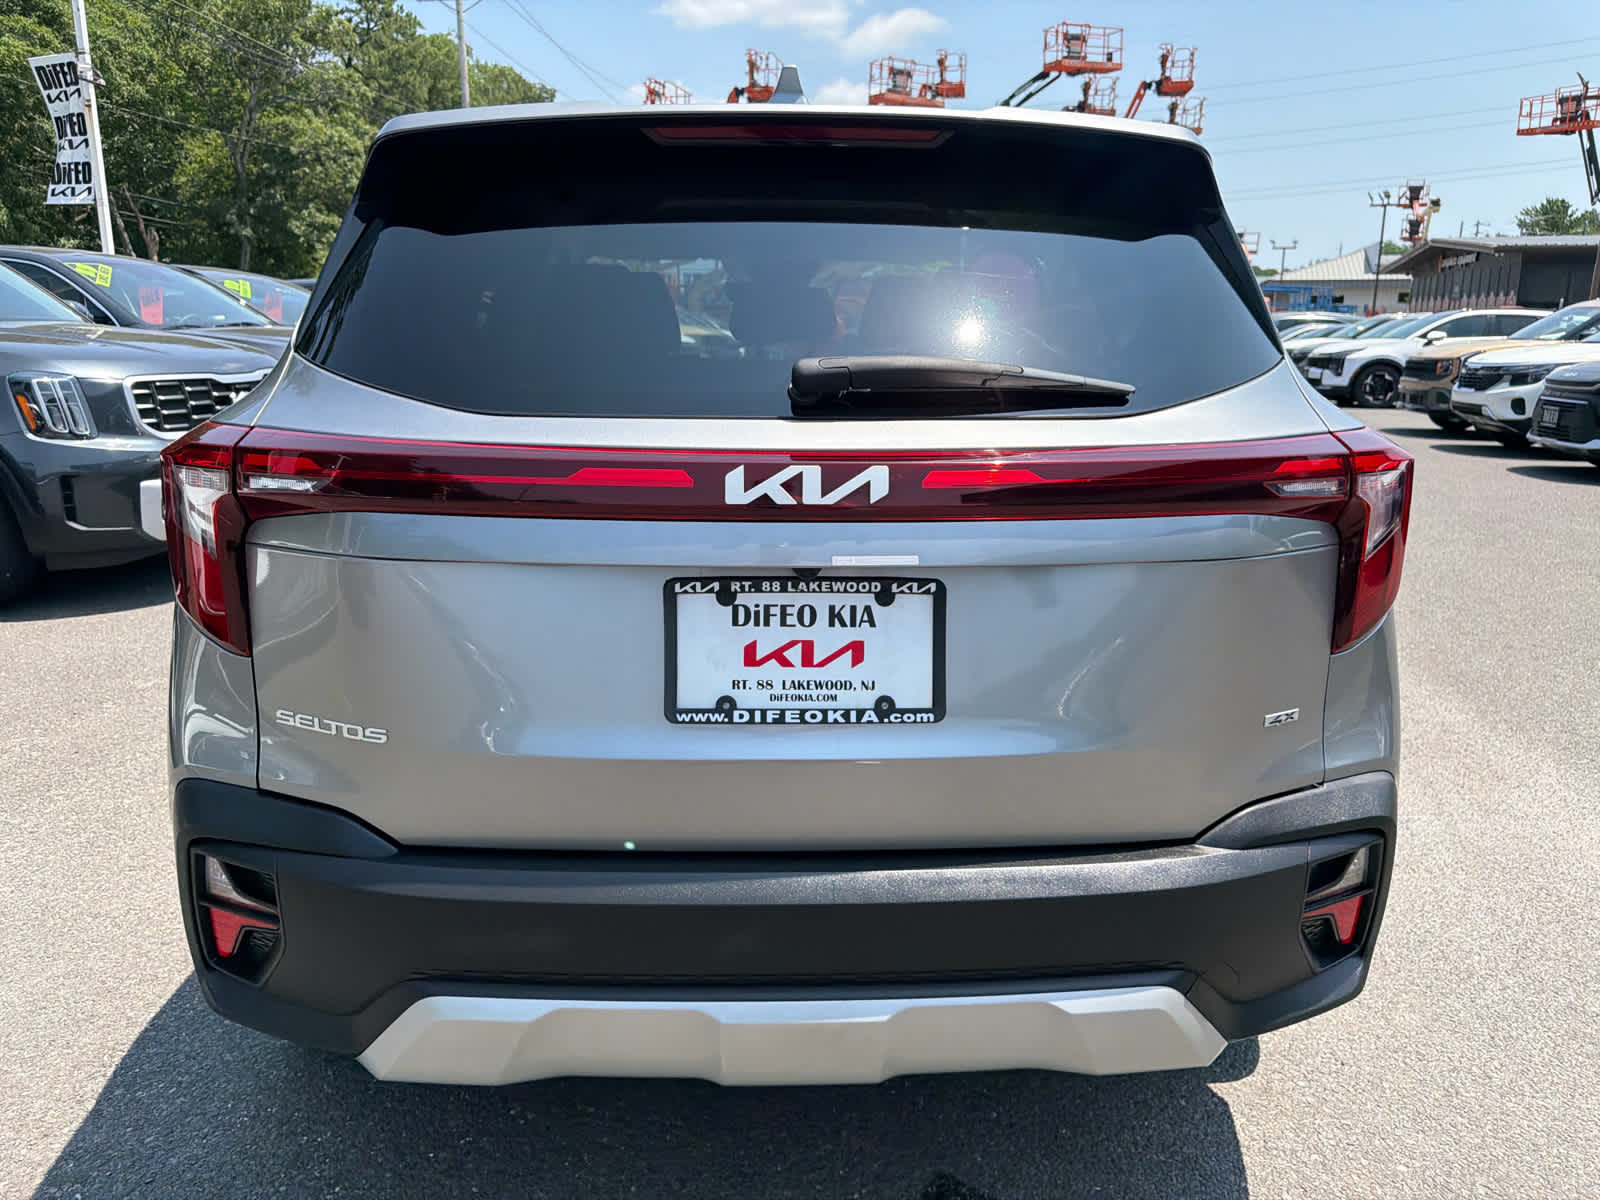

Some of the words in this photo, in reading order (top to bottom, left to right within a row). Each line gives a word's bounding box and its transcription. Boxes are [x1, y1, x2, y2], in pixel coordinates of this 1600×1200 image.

[46, 87, 82, 104] KIA
[50, 185, 92, 197] KIA
[724, 463, 890, 505] KIA
[674, 581, 720, 593] KIA
[730, 581, 756, 593] RT.
[761, 581, 781, 593] 88
[787, 581, 882, 593] LAKEWOOD
[891, 582, 937, 593] KIA
[731, 603, 818, 628] DiFEO
[828, 604, 877, 628] KIA
[743, 639, 865, 668] KIA
[731, 679, 752, 691] RT.
[756, 679, 774, 691] 88
[781, 679, 857, 692] LAKEWOOD,
[860, 679, 876, 691] NJ
[676, 709, 935, 723] www.DIFEOKIA.com
[275, 709, 388, 743] SELTOS
